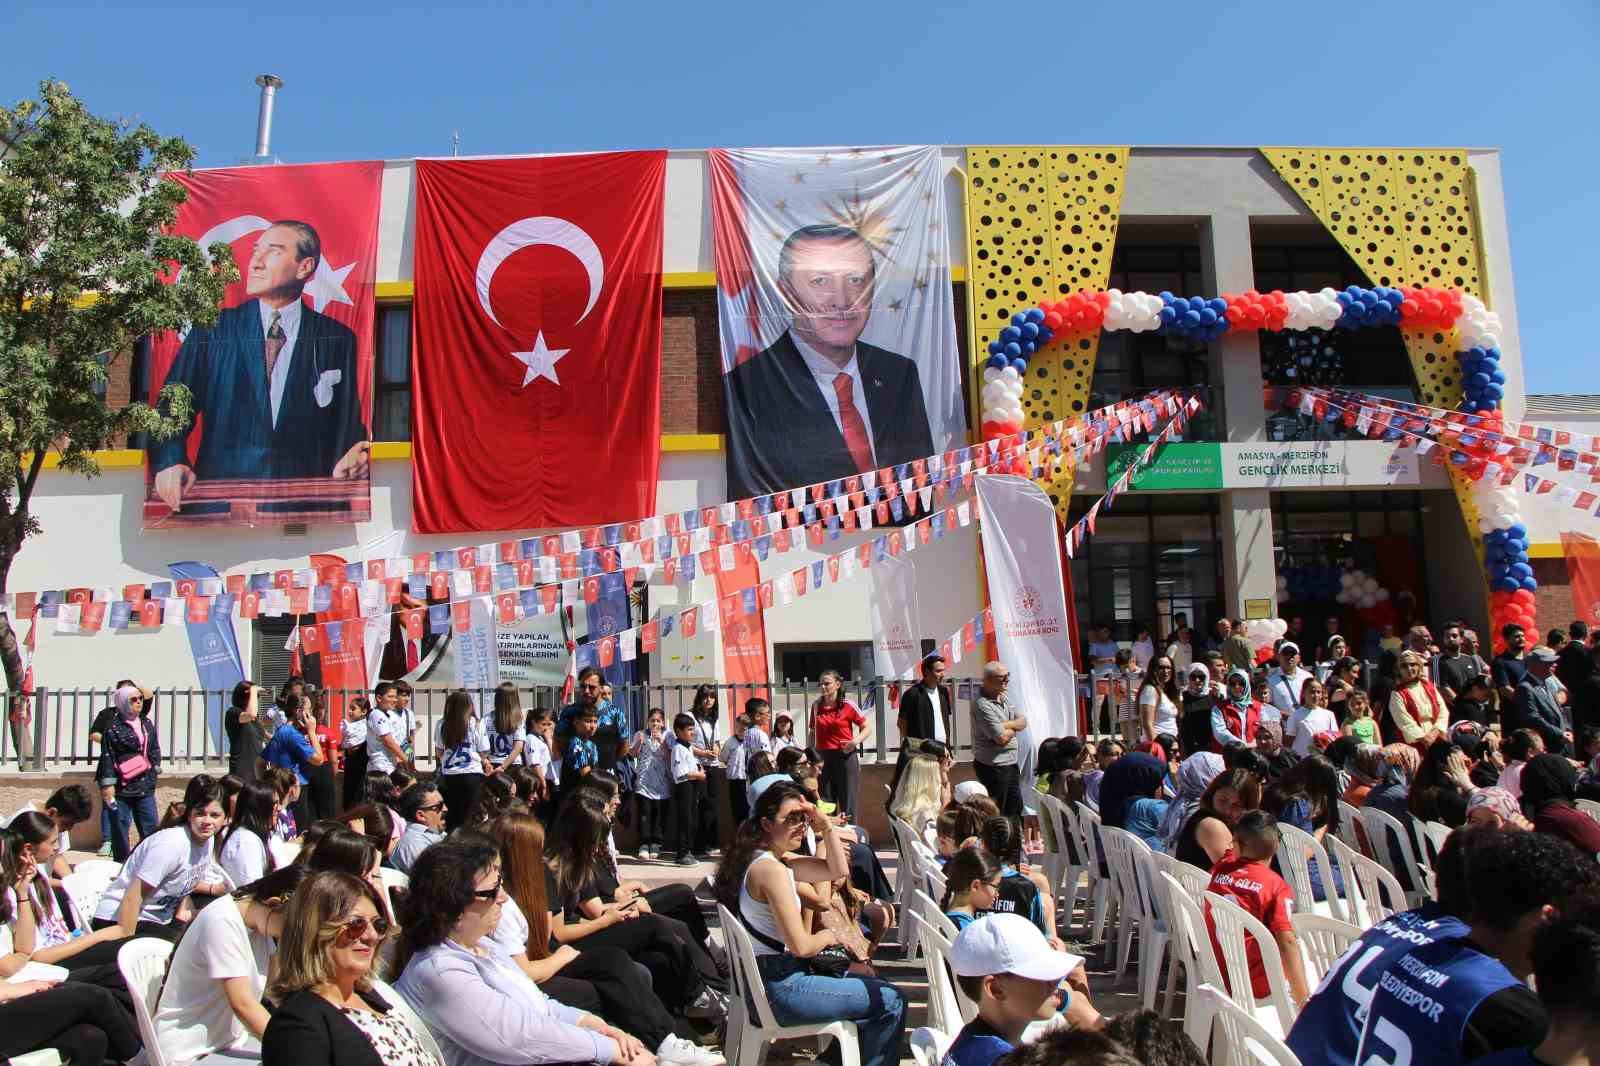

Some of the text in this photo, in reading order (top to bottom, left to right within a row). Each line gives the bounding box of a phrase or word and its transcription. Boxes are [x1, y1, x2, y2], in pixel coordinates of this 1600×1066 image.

[1238, 452, 1274, 460] AMASYA
[1239, 463, 1340, 478] GENÇLİK MERKEZİ
[513, 633, 549, 641] YAPILAN
